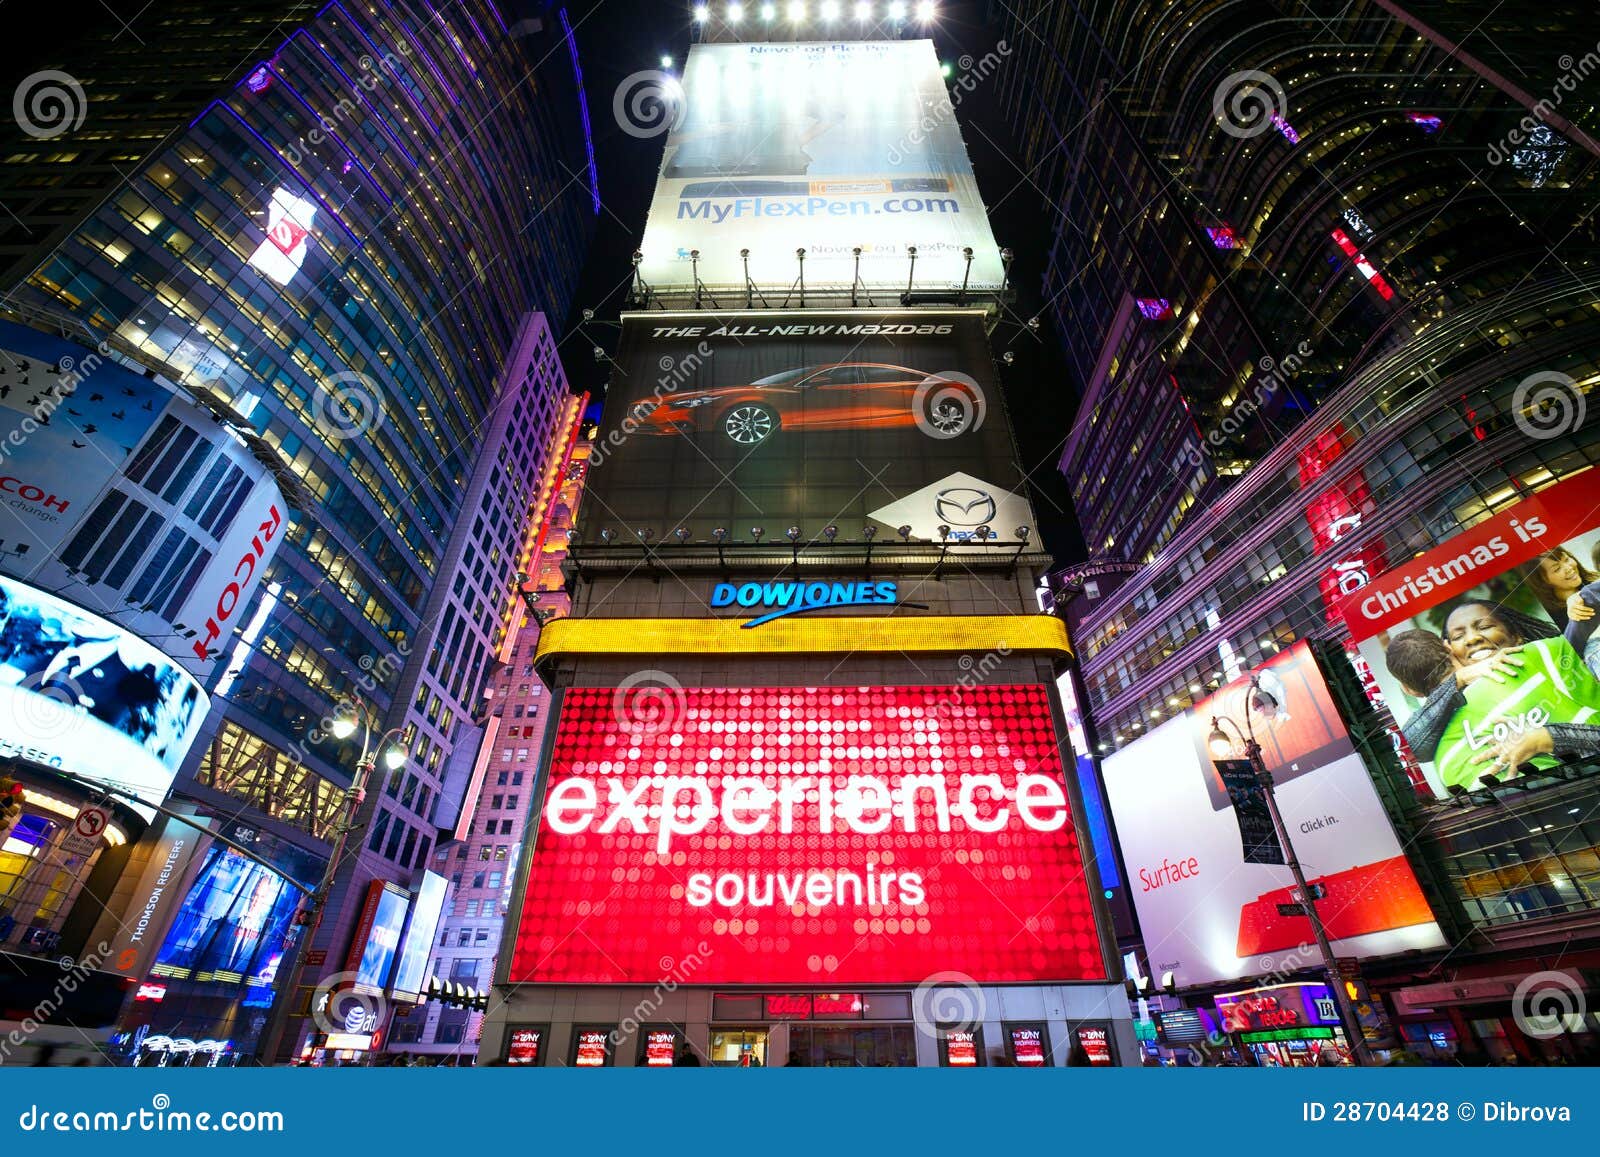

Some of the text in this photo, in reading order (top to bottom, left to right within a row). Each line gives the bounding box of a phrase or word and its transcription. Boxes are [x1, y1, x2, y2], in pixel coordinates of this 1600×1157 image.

[677, 197, 960, 223] MyFlexPen.com
[651, 326, 705, 338] THE
[707, 325, 835, 337] ALL-NEW
[193, 504, 281, 662] RICOH
[1361, 534, 1510, 620] Christmas
[1509, 514, 1548, 543] is
[1463, 706, 1550, 751] Love
[546, 771, 1068, 854] experience
[1300, 813, 1340, 834] Click in.
[131, 839, 184, 943] THOMSON REUTERS
[686, 863, 926, 908] souvenirs
[1139, 857, 1200, 892] Surface
